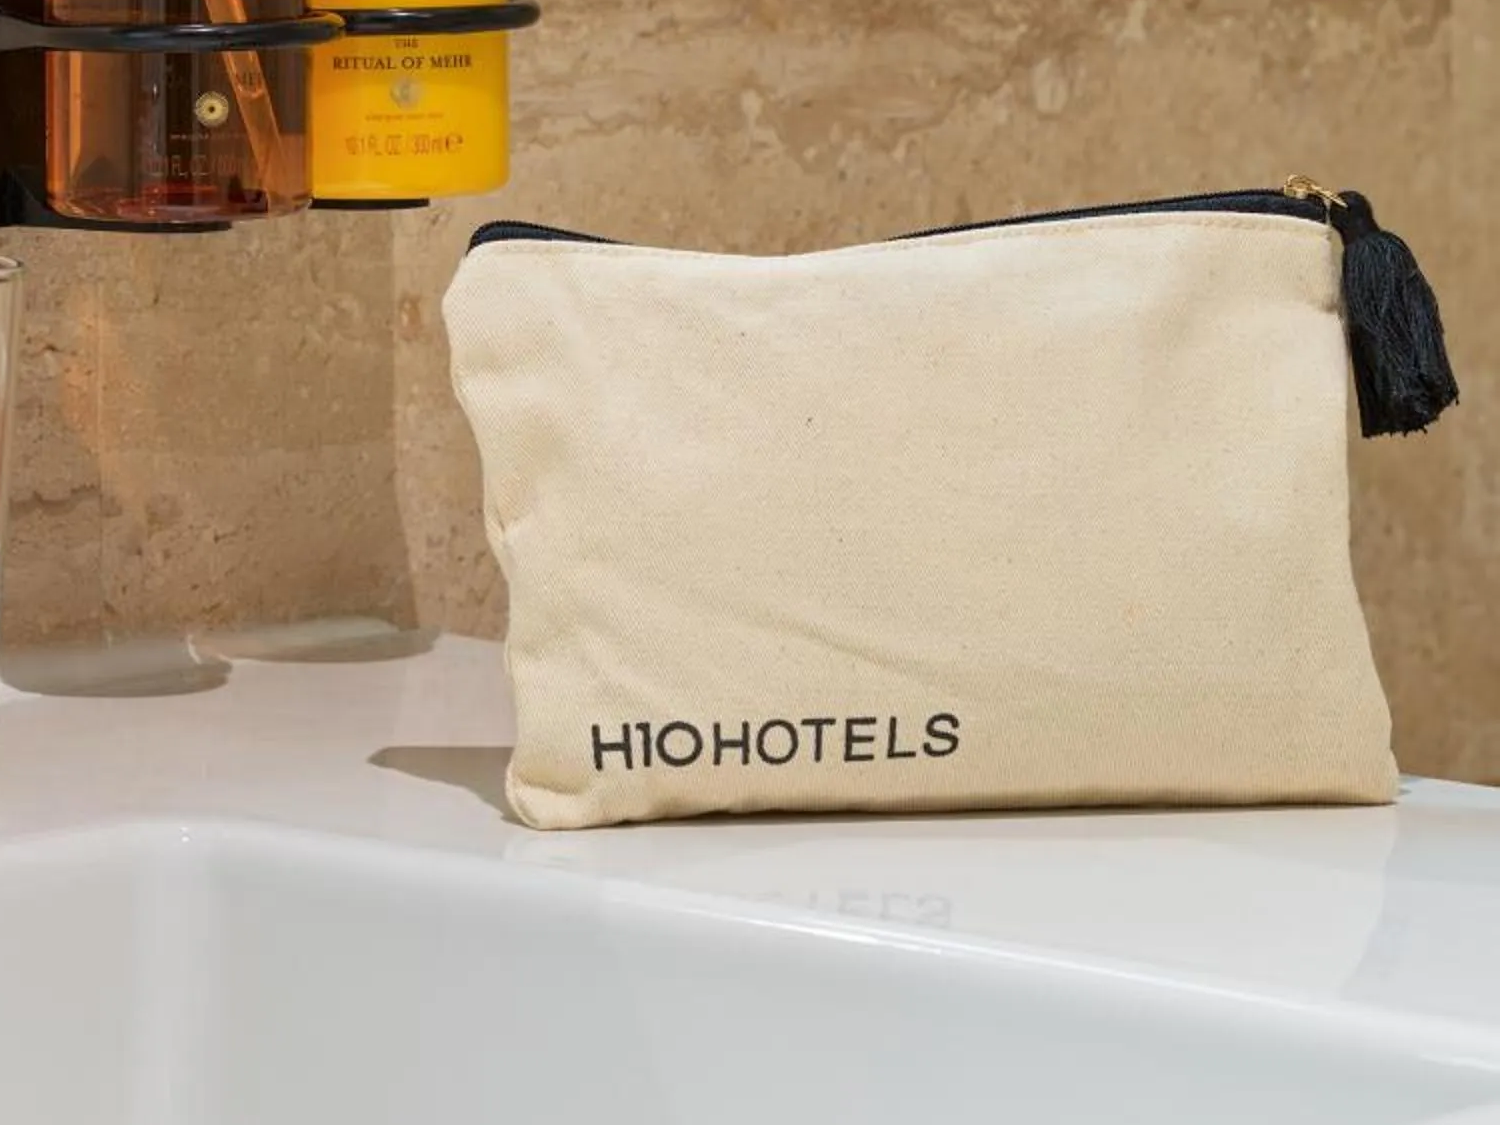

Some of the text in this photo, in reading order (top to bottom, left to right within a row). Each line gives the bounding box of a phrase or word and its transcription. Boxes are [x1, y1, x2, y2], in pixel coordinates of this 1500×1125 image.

[393, 37, 420, 49] THE
[332, 53, 473, 70] RITUAL OF MEHR
